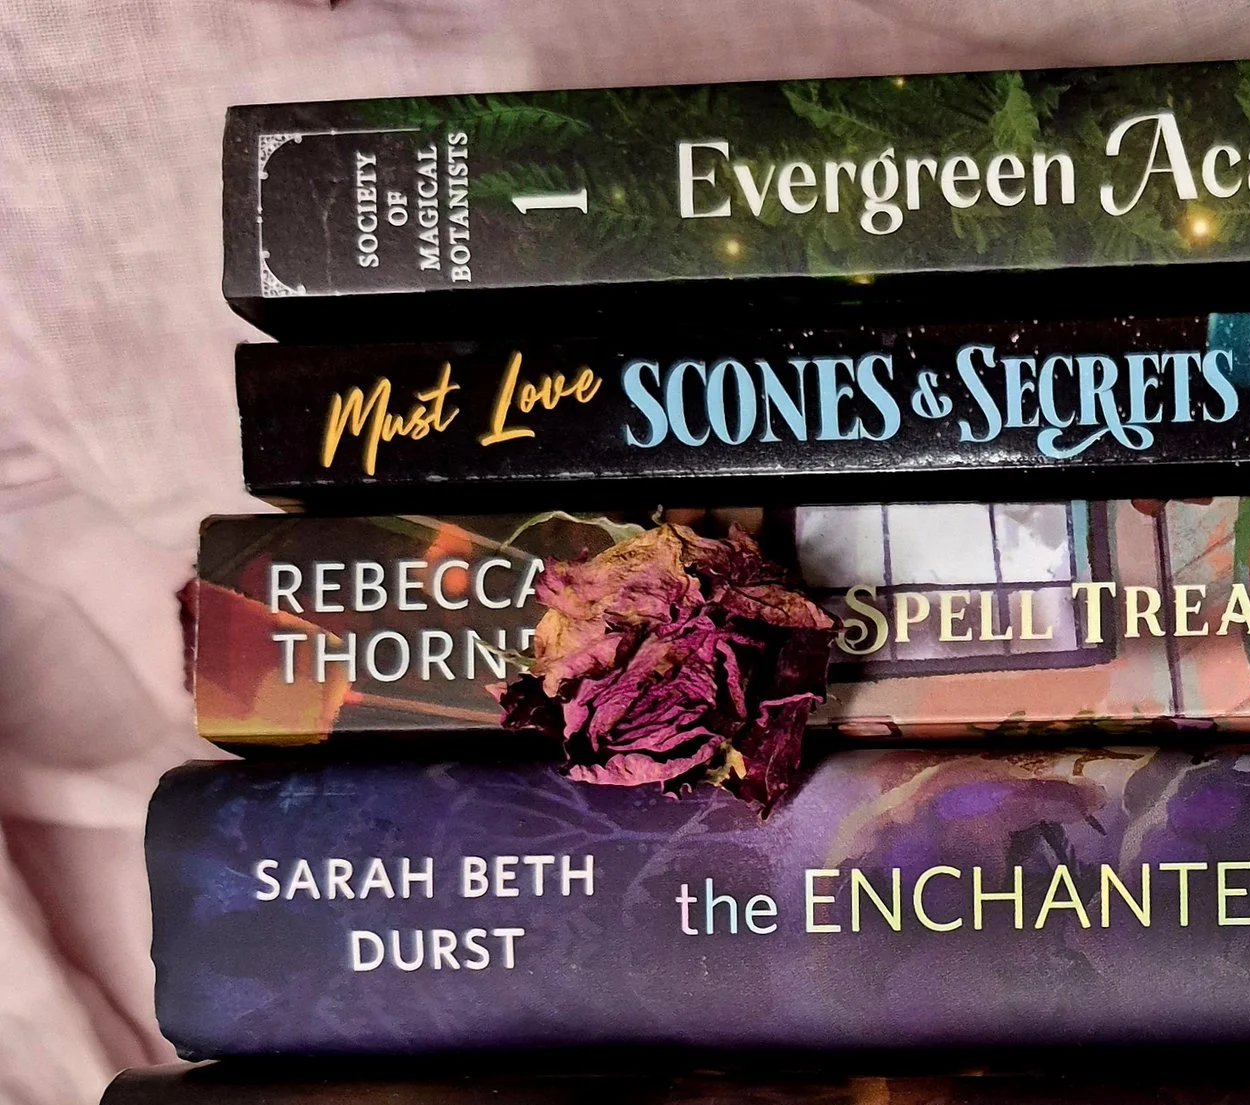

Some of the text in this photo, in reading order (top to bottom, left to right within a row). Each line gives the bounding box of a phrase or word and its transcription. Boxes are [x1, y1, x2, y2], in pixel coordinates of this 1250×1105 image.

[356, 150, 379, 268] SOCIETY
[387, 190, 408, 227] OF
[417, 143, 441, 271] MAGICAL
[448, 131, 472, 283] BOTANISTS
[511, 187, 588, 214] 1
[678, 140, 1076, 236] Evergreen
[320, 350, 602, 476] Must Love
[621, 344, 1240, 460] SCONES & SECRETS
[269, 557, 546, 615] REBECCA
[834, 583, 1054, 656] SPELL
[254, 853, 595, 901] SARAH BETH
[676, 878, 778, 936] the
[350, 927, 526, 972] DURST
